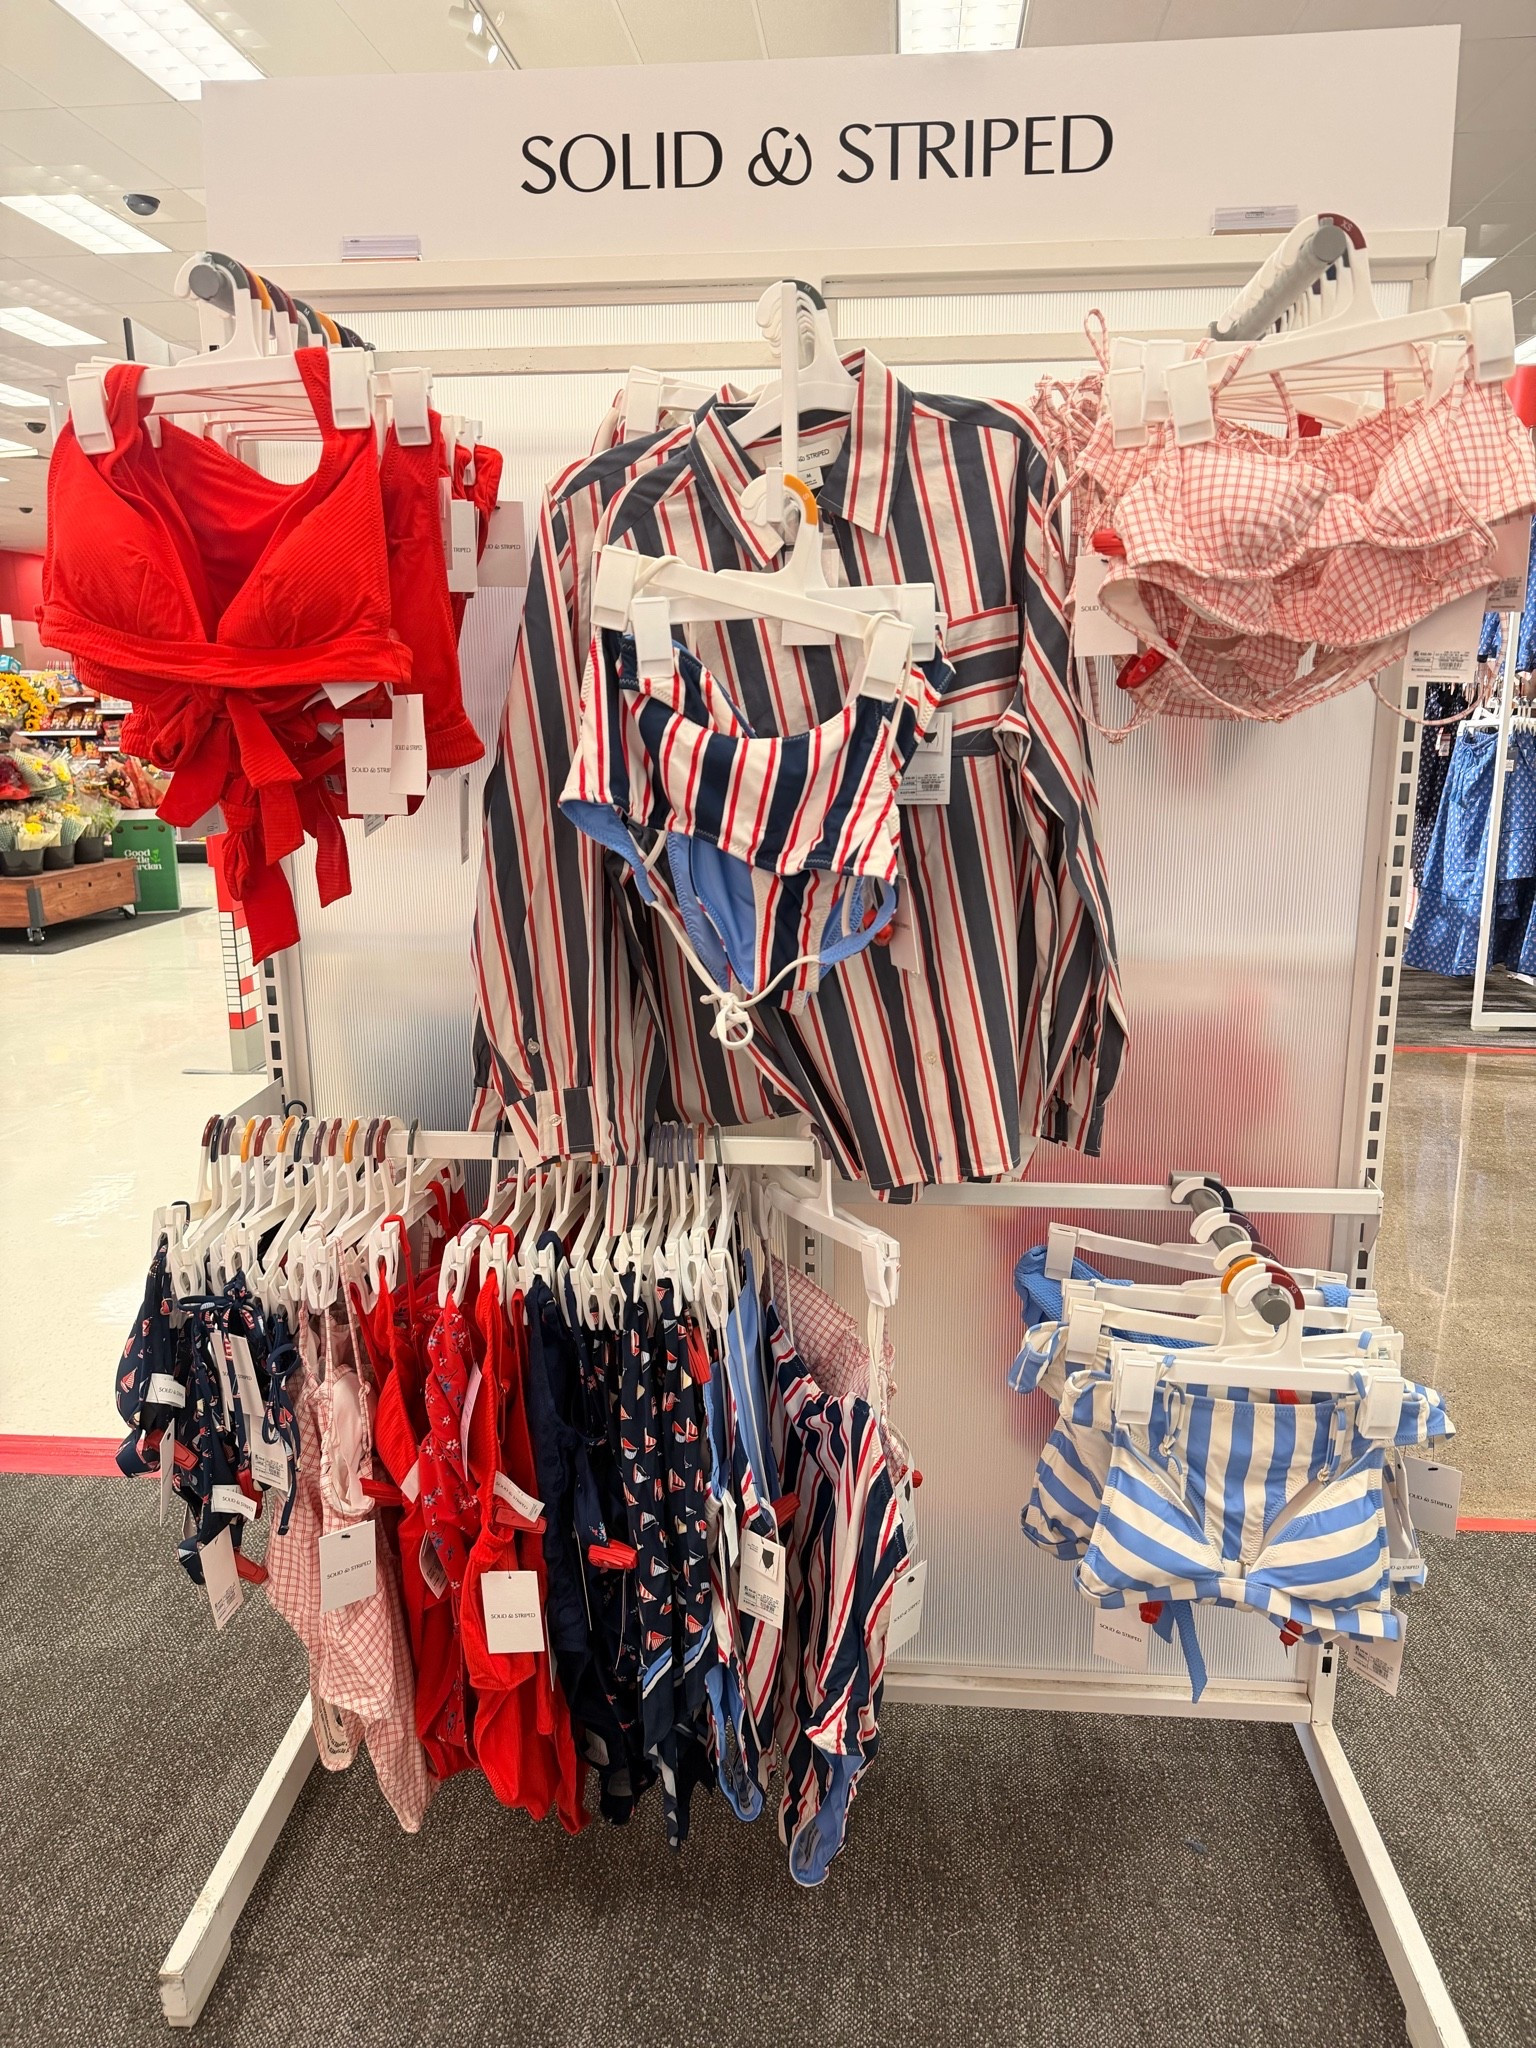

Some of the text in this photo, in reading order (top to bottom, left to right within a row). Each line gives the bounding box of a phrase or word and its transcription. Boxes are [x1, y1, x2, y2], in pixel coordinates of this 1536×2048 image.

[520, 114, 1114, 195] SOLID & STRIPED
[1341, 220, 1353, 232] XS
[228, 261, 236, 270] M
[803, 285, 812, 293] M
[303, 307, 311, 316] M
[806, 448, 830, 461] STRIPED
[123, 848, 151, 857] Good
[1244, 1223, 1253, 1232] XL
[1288, 1283, 1299, 1294] XS
[1408, 1492, 1423, 1501] OLID
[1430, 1499, 1453, 1509] STRIPED
[326, 1569, 344, 1580] SOLID
[350, 1559, 372, 1572] STRIPED
[1099, 1623, 1116, 1633] SOLID
[1121, 1631, 1143, 1643] STRIPED
